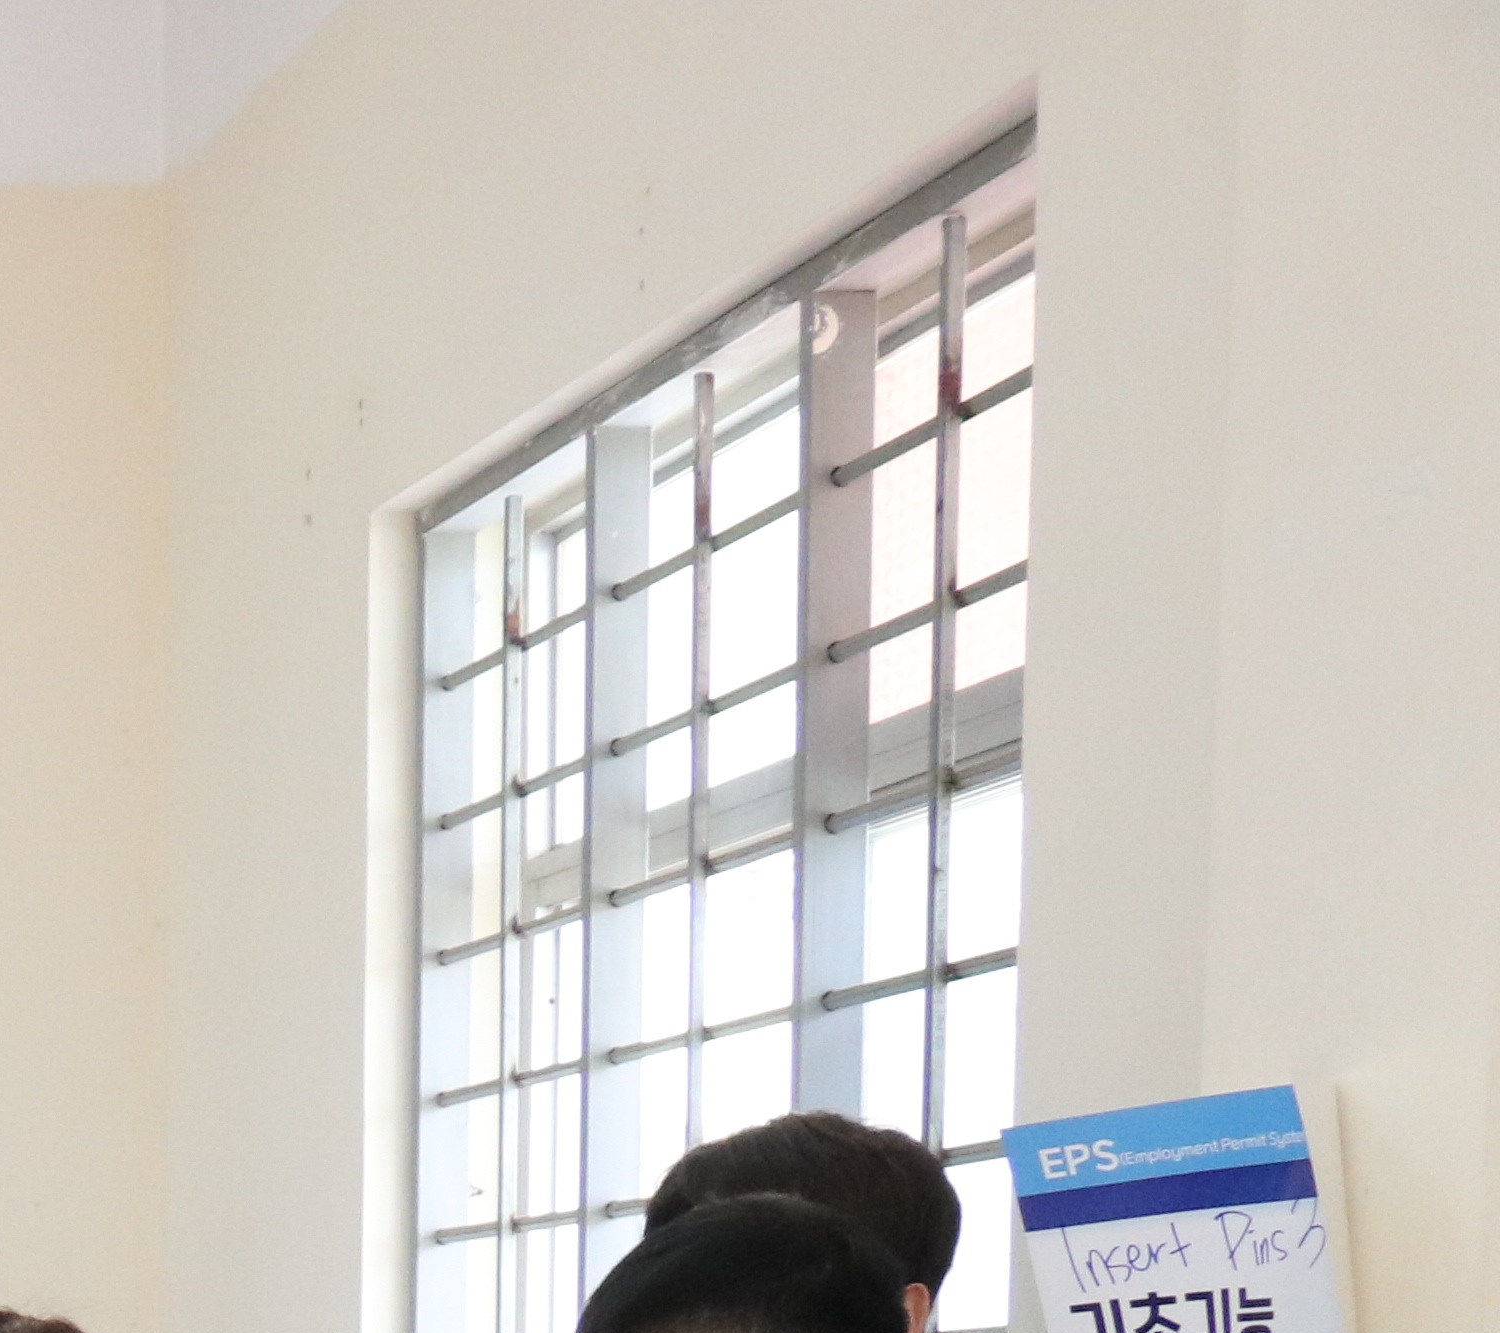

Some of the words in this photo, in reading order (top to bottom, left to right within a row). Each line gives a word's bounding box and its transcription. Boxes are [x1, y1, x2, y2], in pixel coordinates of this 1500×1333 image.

[1038, 1138, 1120, 1180] EPS
[1220, 1134, 1267, 1153] Permit
[1061, 1222, 1192, 1293] Insert
[1214, 1210, 1287, 1271] Pins
